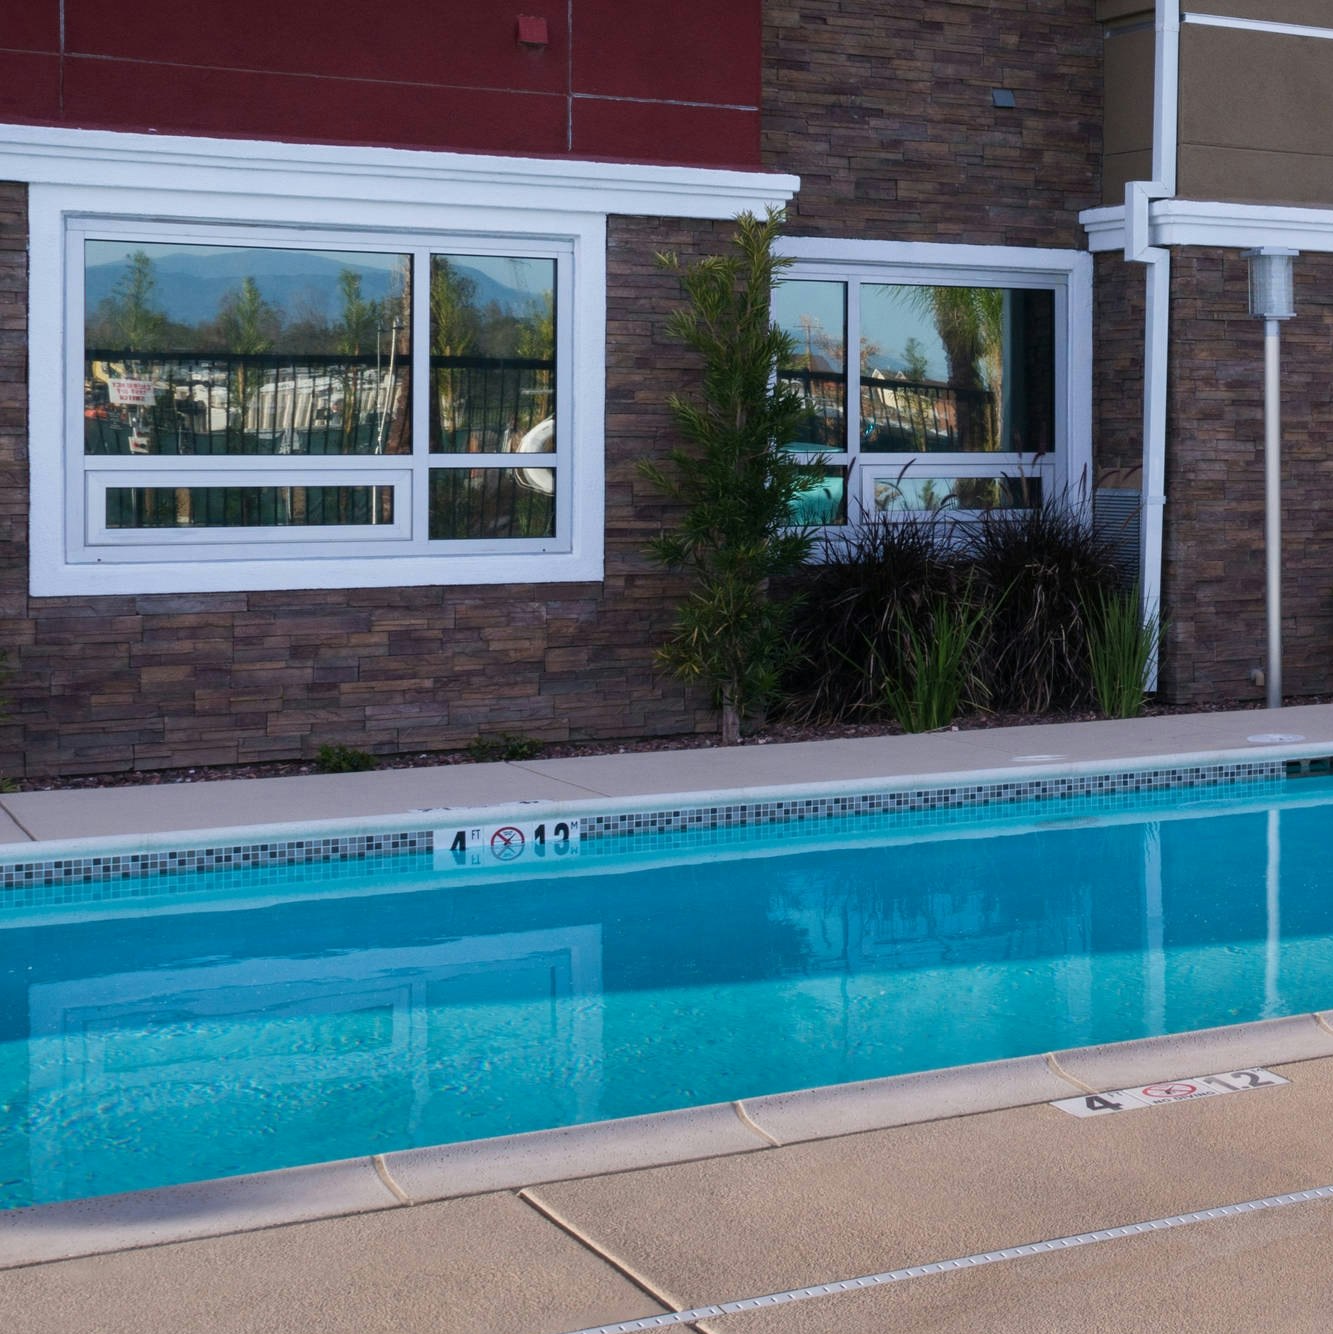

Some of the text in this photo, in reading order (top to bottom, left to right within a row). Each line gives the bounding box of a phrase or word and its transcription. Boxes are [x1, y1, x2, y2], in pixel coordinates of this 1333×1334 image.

[570, 821, 578, 829] M
[471, 829, 480, 840] FT
[1173, 1091, 1215, 1101] DIVING
[1085, 1095, 1124, 1111] 4
